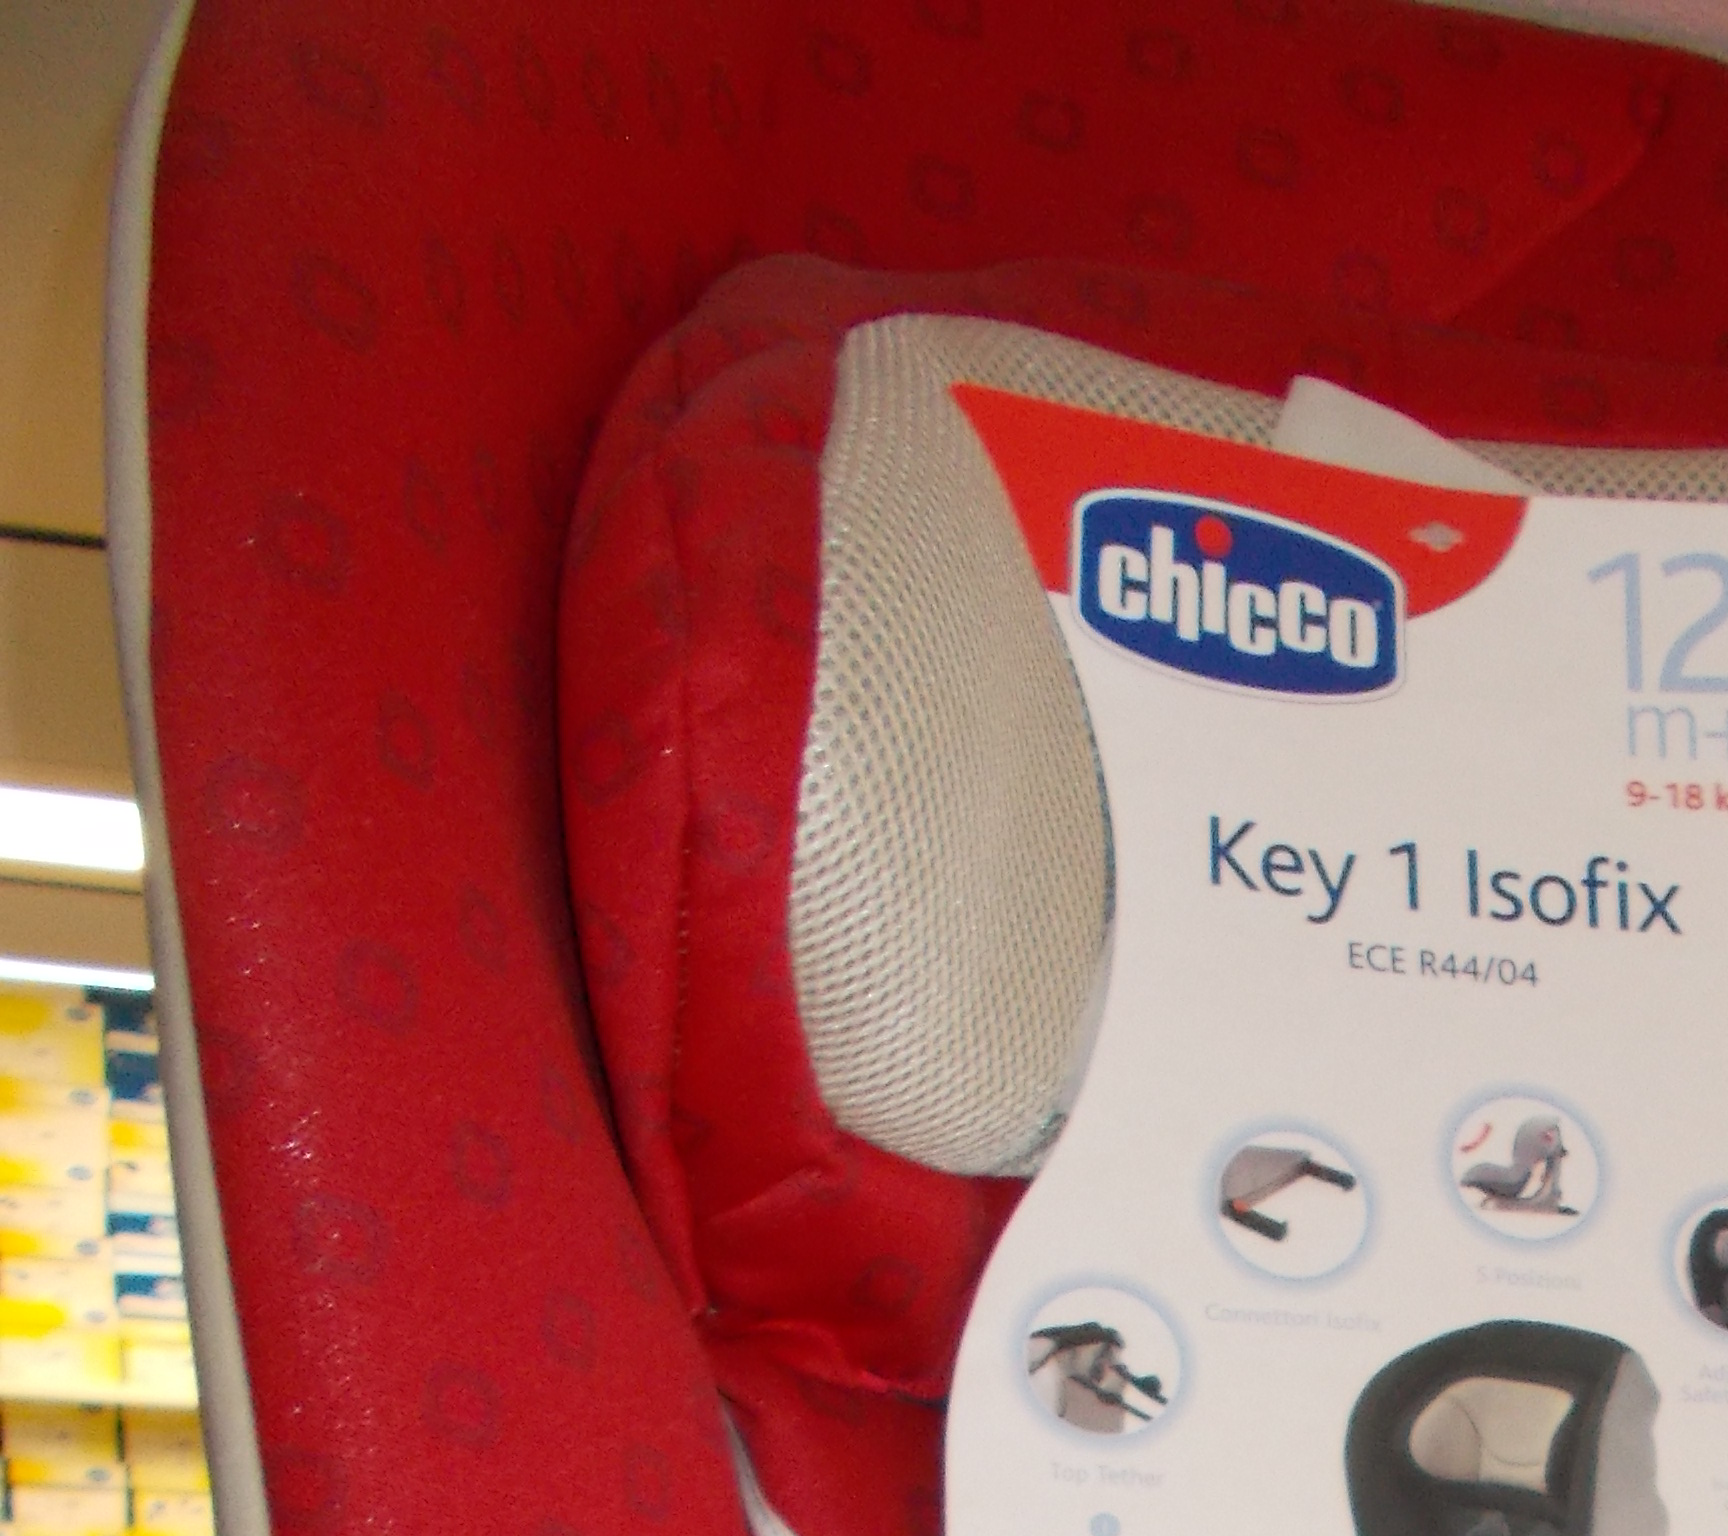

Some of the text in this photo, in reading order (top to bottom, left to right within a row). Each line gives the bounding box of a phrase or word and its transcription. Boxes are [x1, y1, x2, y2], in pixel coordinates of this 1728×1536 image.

[1099, 516, 1378, 667] chicco
[1626, 781, 1705, 811] 9-18
[1209, 815, 1682, 935] Key 1 Isofix
[1348, 941, 1539, 988] ECE R44/04
[1204, 1302, 1320, 1328] Connettori
[1050, 1460, 1166, 1489] Top Tether
